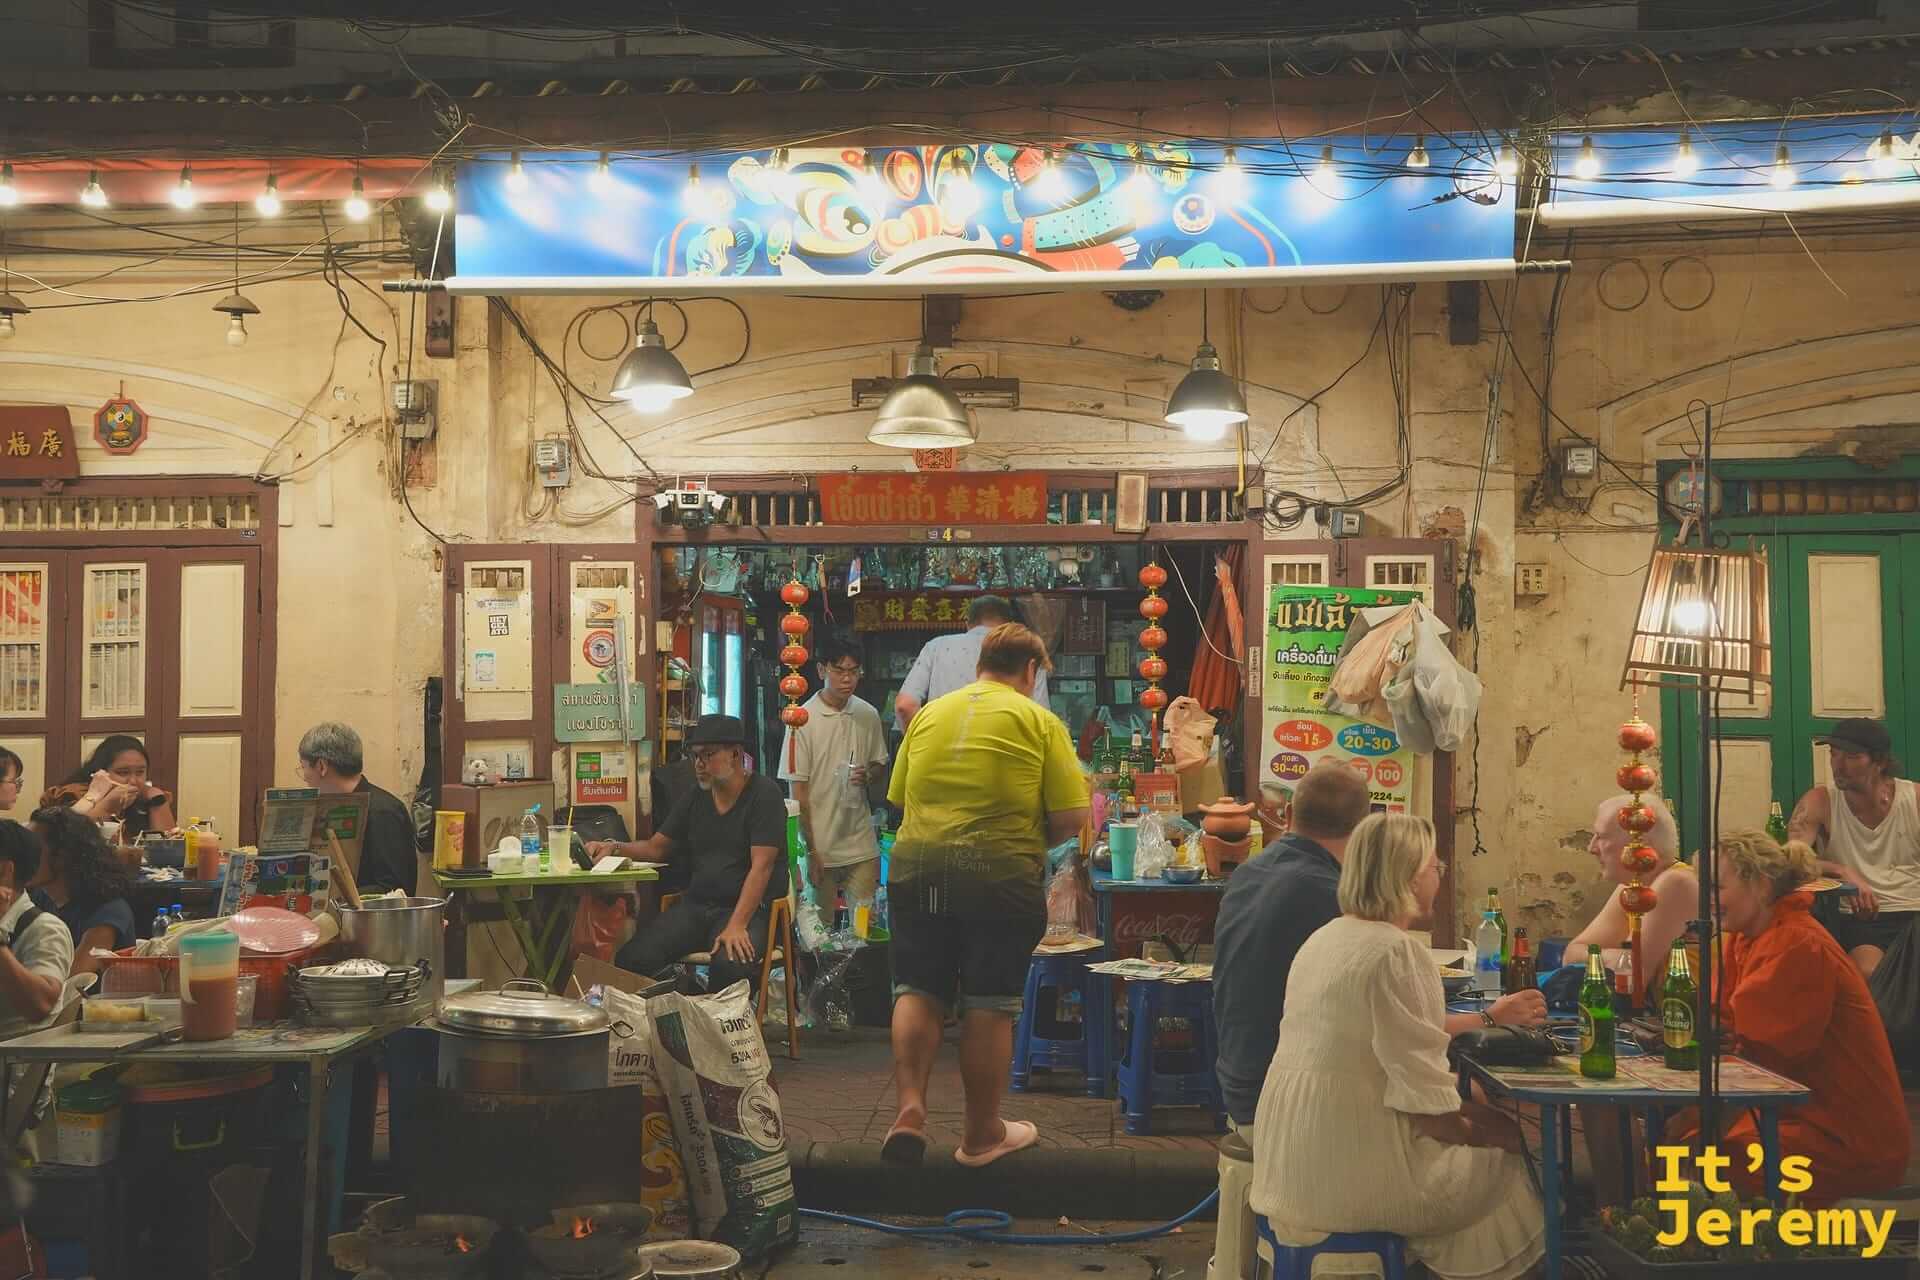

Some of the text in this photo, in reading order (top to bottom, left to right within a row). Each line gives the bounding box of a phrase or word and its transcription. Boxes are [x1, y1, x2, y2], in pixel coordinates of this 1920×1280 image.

[1277, 643, 1337, 665] เครื่องดื่ม
[562, 689, 638, 705] สถานที่ขายา
[1272, 762, 1306, 775] 30-40
[1376, 768, 1401, 782] 100
